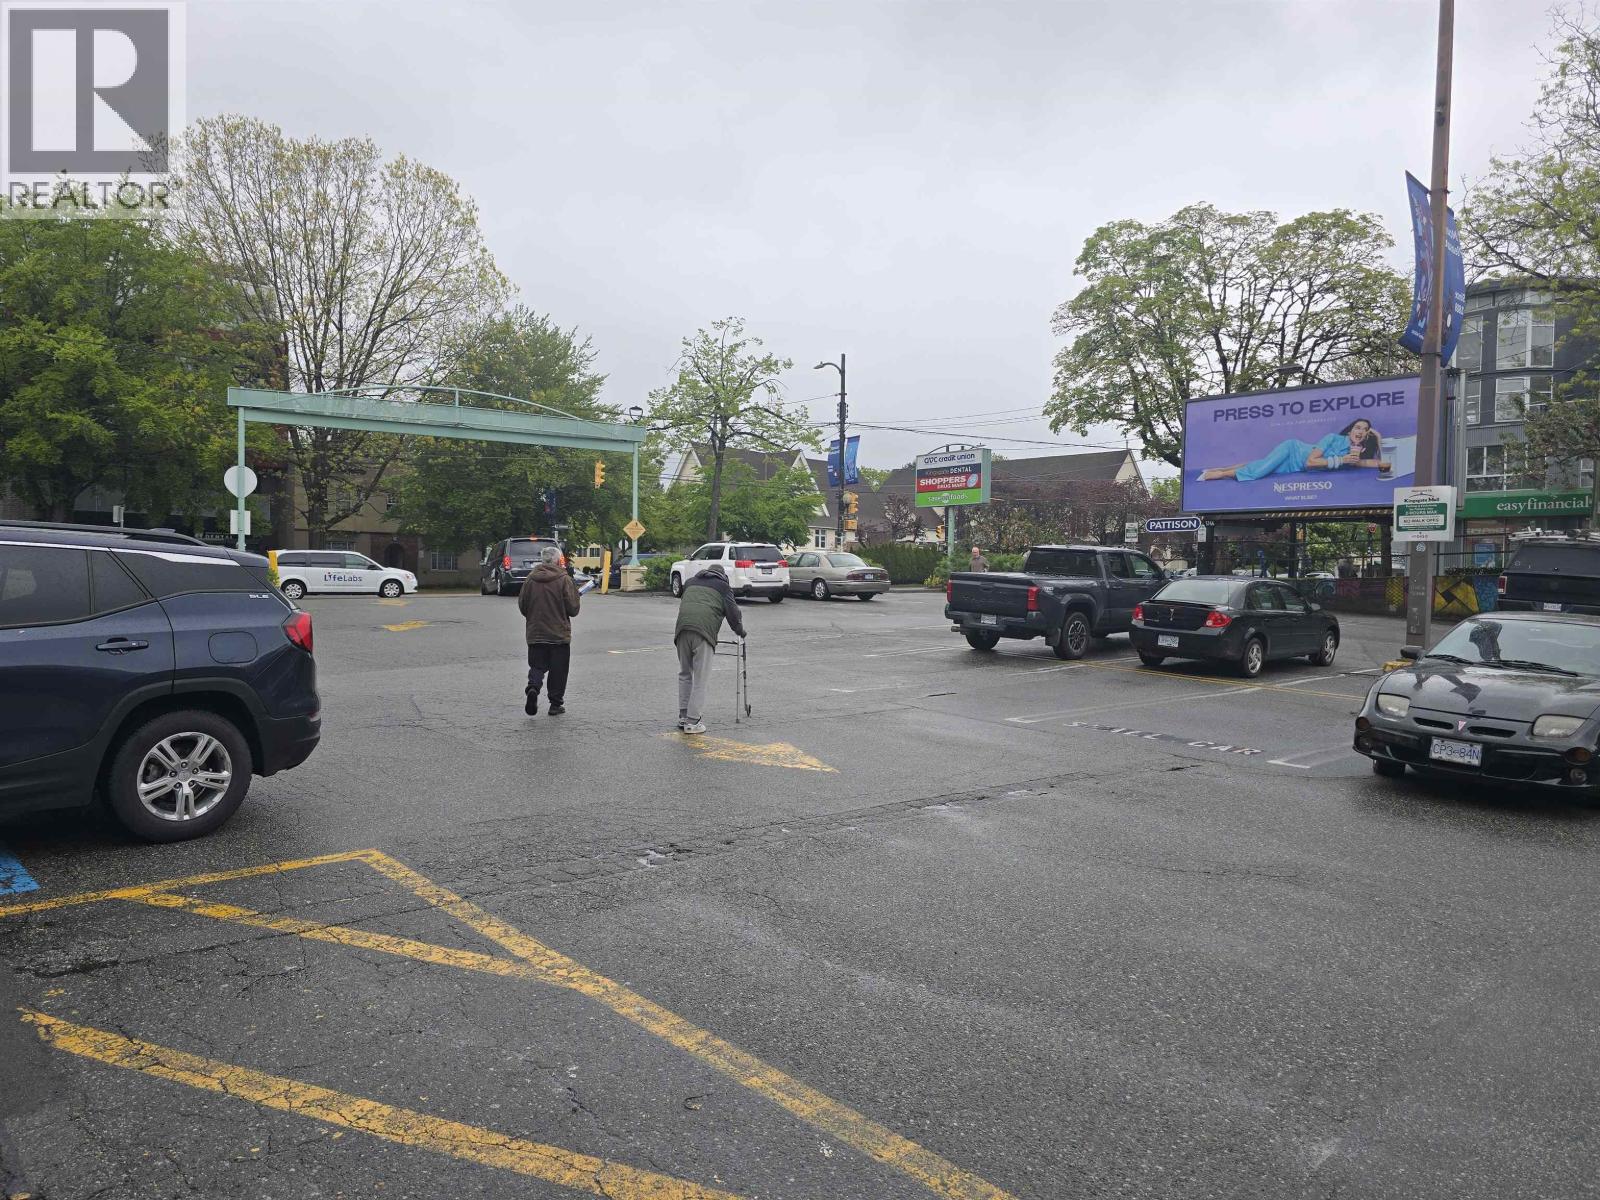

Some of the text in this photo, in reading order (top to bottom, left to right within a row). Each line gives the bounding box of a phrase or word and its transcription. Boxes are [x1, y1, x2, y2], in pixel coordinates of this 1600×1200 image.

[1213, 405, 1274, 423] PRESS
[1279, 401, 1305, 416] TO
[1309, 390, 1406, 413] EXPLORE
[950, 466, 972, 474] DENTAL
[920, 475, 967, 486] SHOPPERS
[1273, 480, 1333, 494] NESPRESSO
[1496, 495, 1589, 514] easyfinancial
[1149, 520, 1197, 530] PATTISON
[324, 571, 363, 582] LifeLabs
